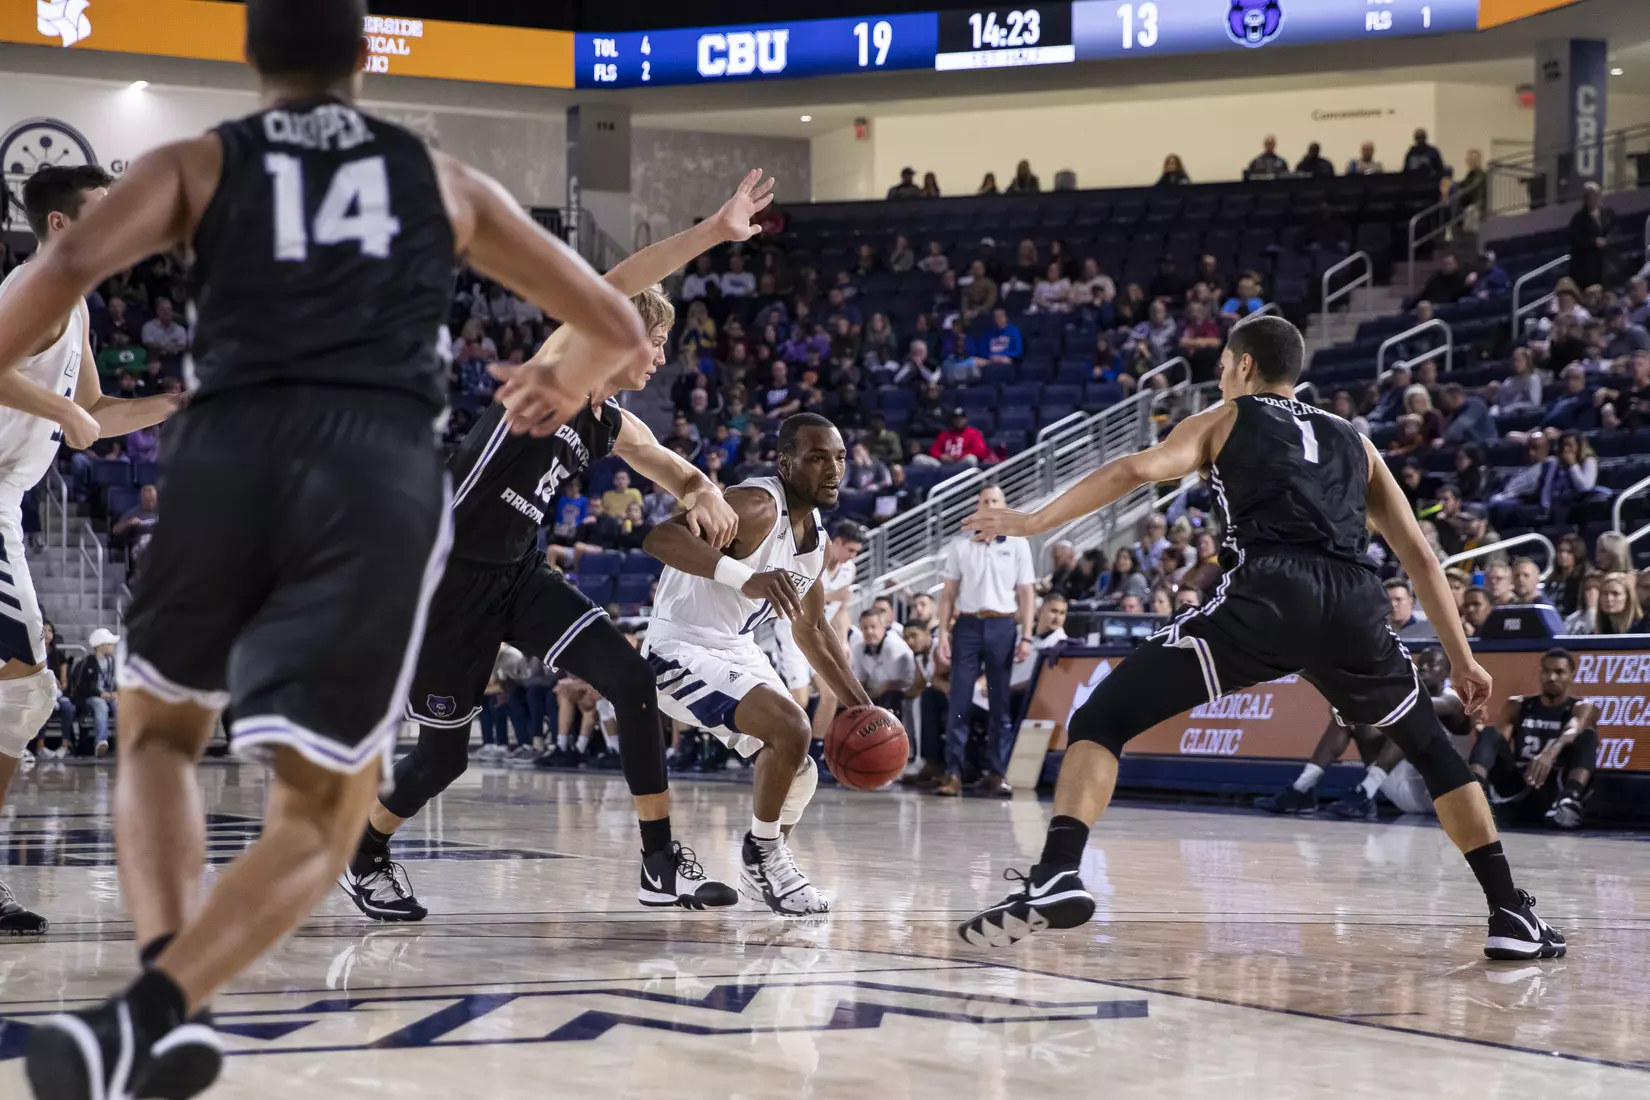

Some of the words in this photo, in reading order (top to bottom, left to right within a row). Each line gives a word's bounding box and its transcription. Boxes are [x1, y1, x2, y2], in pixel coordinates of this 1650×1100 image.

[968, 9, 1040, 48] 14:23
[1116, 2, 1158, 49] 13
[1421, 5, 1431, 28] 1
[593, 38, 619, 58] TOL
[640, 35, 651, 56] 4
[697, 28, 790, 78] CBU
[853, 20, 892, 66] 19
[593, 63, 618, 82] FLS
[641, 60, 651, 82] 2
[264, 153, 401, 262] 14
[1292, 415, 1319, 464] 1
[534, 456, 571, 504] 15
[1180, 727, 1244, 755] CLINIC
